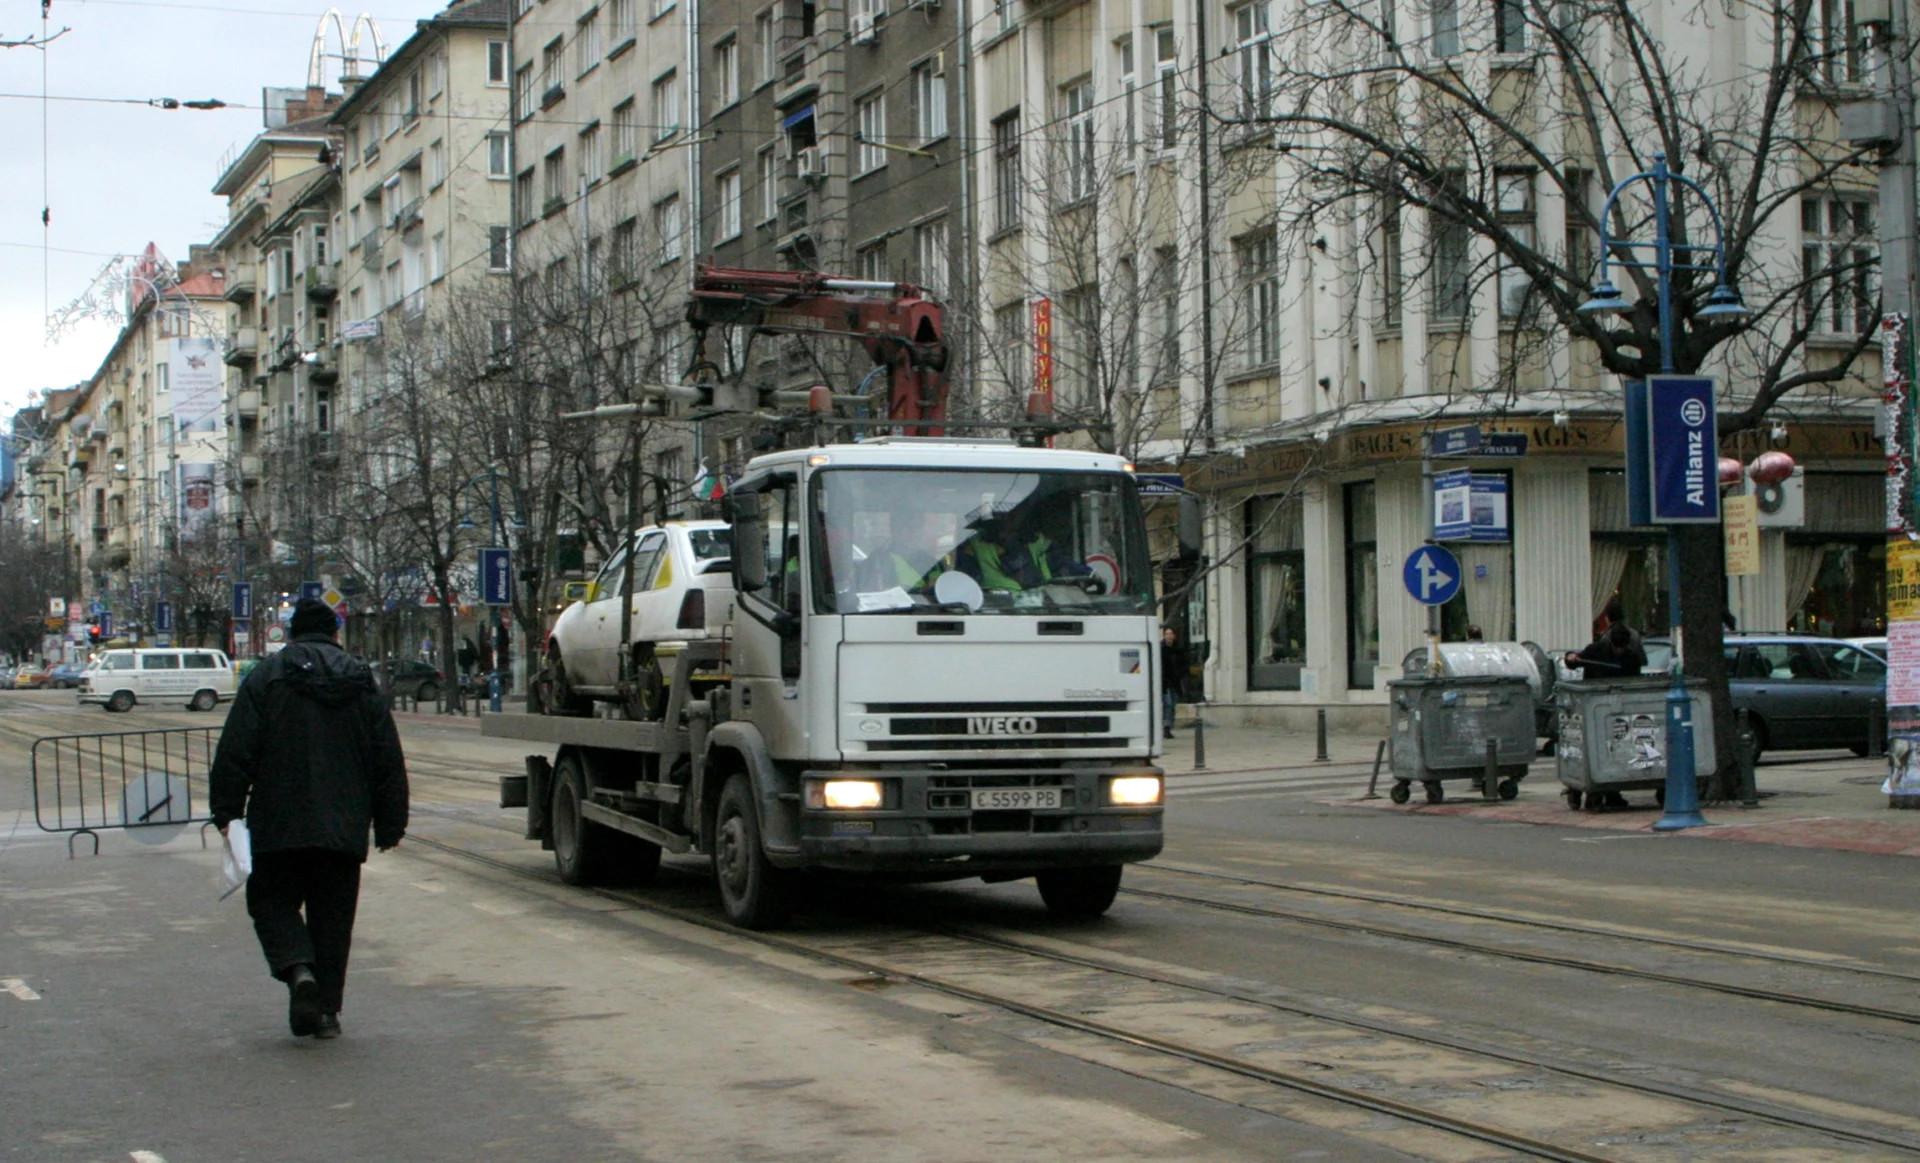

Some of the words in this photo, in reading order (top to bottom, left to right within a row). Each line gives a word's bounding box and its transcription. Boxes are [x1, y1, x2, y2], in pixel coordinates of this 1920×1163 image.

[1685, 431, 1704, 506] Allianz
[967, 717, 1037, 735] IVECO
[992, 793, 1030, 807] 5599
[1037, 792, 1055, 807] PB
